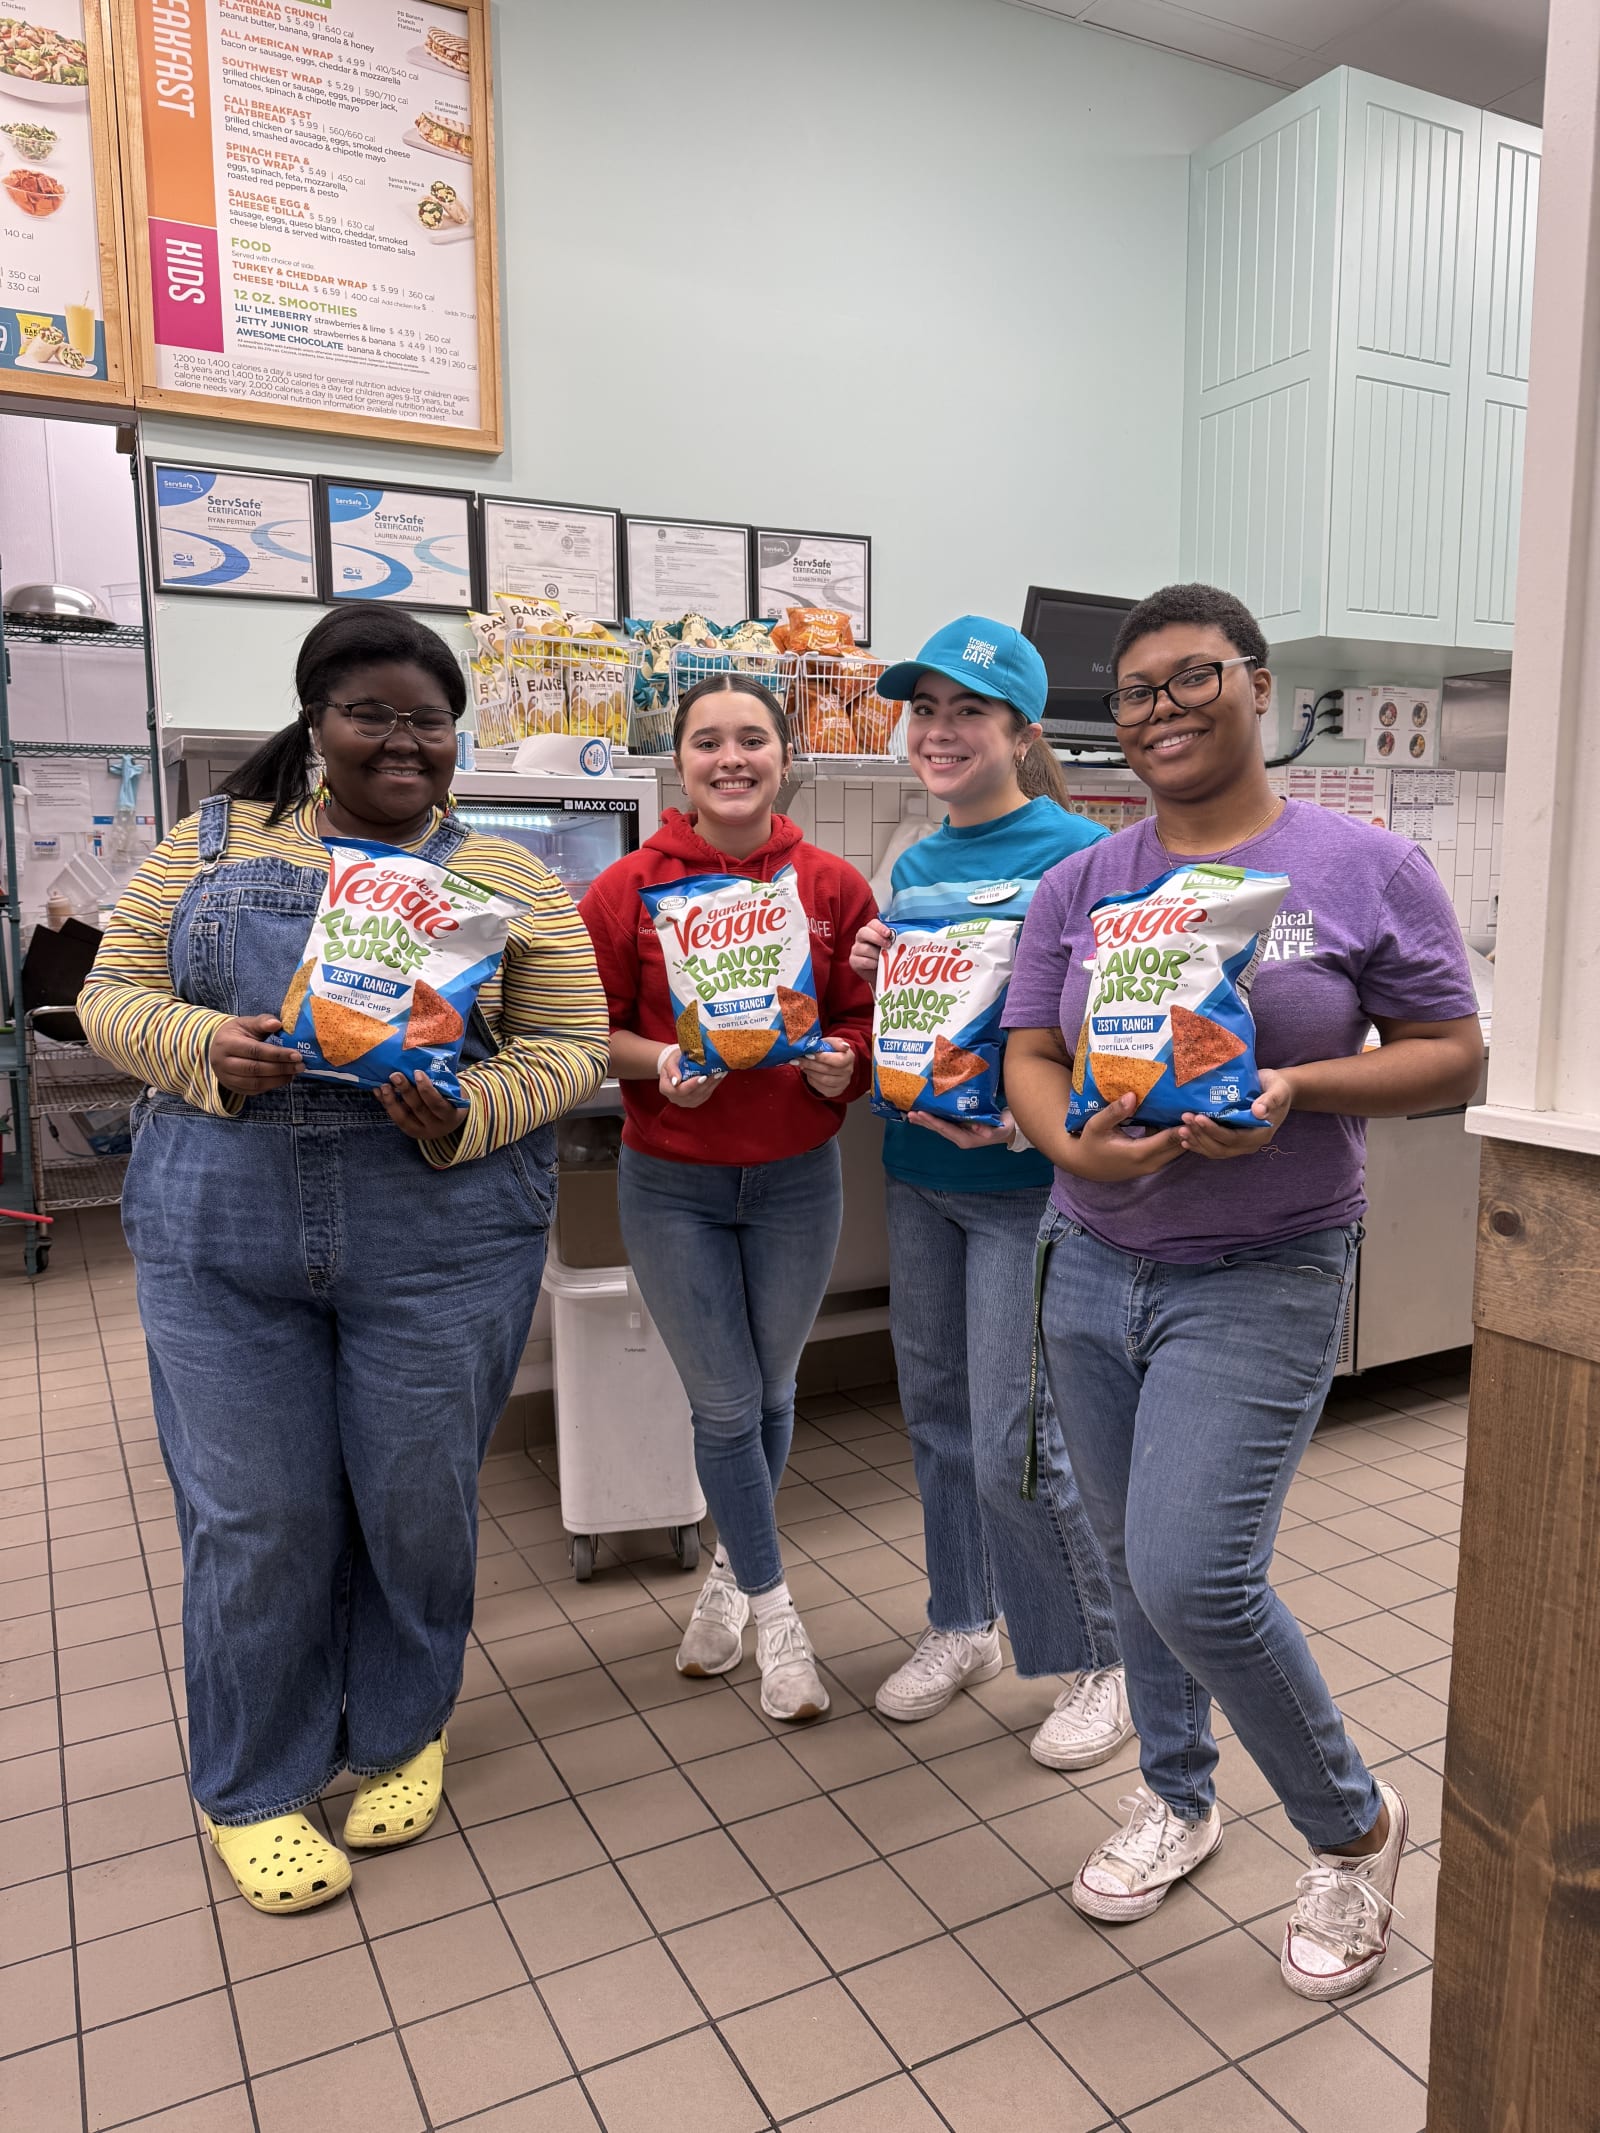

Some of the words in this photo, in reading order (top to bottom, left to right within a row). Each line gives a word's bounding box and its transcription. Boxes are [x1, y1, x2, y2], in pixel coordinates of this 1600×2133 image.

[218, 0, 282, 21] FLATBREAD
[295, 17, 314, 29] 5.49
[324, 24, 342, 35] 640
[342, 29, 354, 39] cal
[236, 0, 281, 12] ANANA
[285, 6, 327, 23] CRUNCH
[219, 10, 248, 22] peanut
[250, 16, 277, 30] butter,
[278, 22, 310, 38] banana,
[311, 32, 341, 44] granola
[350, 39, 374, 53] honey
[220, 28, 241, 41] ALL
[243, 33, 299, 53] AMERICAN
[301, 46, 333, 60] WRAP
[345, 56, 365, 67] 4.99
[375, 64, 408, 79] 410/540
[407, 71, 419, 80] cal
[222, 56, 288, 78] SOUTHWEST
[291, 71, 322, 86] WRAP
[333, 81, 354, 93] 5.29
[363, 88, 397, 103] 590/710
[397, 94, 408, 104] cal
[223, 94, 248, 107] CALI
[251, 100, 312, 120] BREAKFAST
[224, 103, 286, 124] FLATBREAD
[298, 118, 318, 130] 5.99
[328, 126, 363, 140] 560/660
[363, 132, 376, 143] cal
[225, 141, 272, 158] SPINACH
[274, 151, 300, 164] FETA
[226, 151, 260, 165] PESTO
[263, 158, 295, 171] WRAP
[308, 167, 326, 178] 5.49
[337, 173, 354, 183] 450
[354, 177, 365, 186] cal
[228, 188, 277, 205] SAUSAGE
[279, 198, 301, 209] EGG
[228, 198, 269, 212] CHEESE
[317, 213, 337, 224] 5.99
[346, 219, 363, 230] 630
[4, 228, 20, 238] 140
[22, 231, 34, 240] cal
[231, 237, 271, 253] FOOD
[8, 270, 27, 280] 350
[28, 272, 41, 282] cal
[166, 237, 206, 304] KIDS
[232, 260, 273, 274] TURKEY
[285, 269, 335, 284] CHEDDAR
[336, 278, 368, 289] WRAP
[380, 284, 398, 294] 5.99
[408, 290, 424, 300] 360
[424, 293, 435, 301] cal
[7, 281, 25, 292] 330
[27, 284, 40, 294] cal
[232, 272, 274, 286] CHEESE
[322, 287, 340, 296] 6.59
[350, 292, 368, 302] 400
[251, 292, 275, 304] OZ.
[278, 296, 357, 317] SMOOTHIES
[235, 315, 267, 326] JETTY
[270, 320, 308, 333] JUNIOR
[312, 328, 359, 341] strawberries
[368, 335, 396, 346] banana
[407, 340, 425, 351] 4.49
[434, 346, 447, 355] 190
[254, 306, 312, 322] LIMEBERRY
[314, 316, 360, 330] strawberries
[369, 324, 386, 334] lime
[397, 328, 415, 338] 4.39
[424, 333, 440, 342] 260
[440, 334, 451, 344] cal
[236, 327, 286, 341] AWESOME
[287, 335, 343, 350] CHOCOLATE
[346, 344, 374, 355] banana
[382, 350, 418, 361] chocolate
[429, 356, 446, 366] 4.29
[451, 360, 466, 369] 260
[466, 360, 478, 372] cal
[207, 496, 261, 509] ServSafe
[207, 506, 262, 517] CERTIFICATION
[374, 512, 424, 525] ServSafe
[374, 523, 424, 533] CERTIFICATION
[793, 558, 831, 568] ServSafe
[969, 636, 998, 652] tropical
[962, 649, 993, 670] CAFE
[574, 800, 606, 811] MAXX
[609, 801, 637, 812] COLD
[376, 870, 440, 900] garden
[1187, 873, 1240, 889] NEW!
[330, 858, 460, 940] Veggie
[708, 899, 756, 923] garden
[320, 908, 431, 964] FLAVOR
[667, 906, 787, 956] Veggie
[949, 922, 985, 936] NEW!
[324, 939, 423, 976] BURST
[908, 942, 947, 961] garden
[1262, 941, 1315, 961] AFE
[682, 944, 784, 983] FLAVOR
[881, 944, 974, 992] Veggie
[330, 969, 361, 986] ZESTY
[363, 976, 397, 995] RANCH
[695, 967, 780, 1002] BURST
[327, 992, 364, 1007] TORTILLA
[368, 1002, 391, 1013] CHIPS
[714, 1002, 738, 1014] ZESTY
[740, 998, 766, 1011] RANCH
[878, 988, 958, 1016] FLAVOR
[718, 1020, 748, 1029] TORTILLA
[750, 1016, 768, 1025] CHIPS
[879, 1012, 946, 1036] BURST
[1097, 1019, 1120, 1032] ZESTY
[1122, 1018, 1153, 1031] RANCH
[297, 1041, 310, 1049] NO
[882, 1040, 901, 1052] ZESTY
[902, 1042, 924, 1053] RANCH
